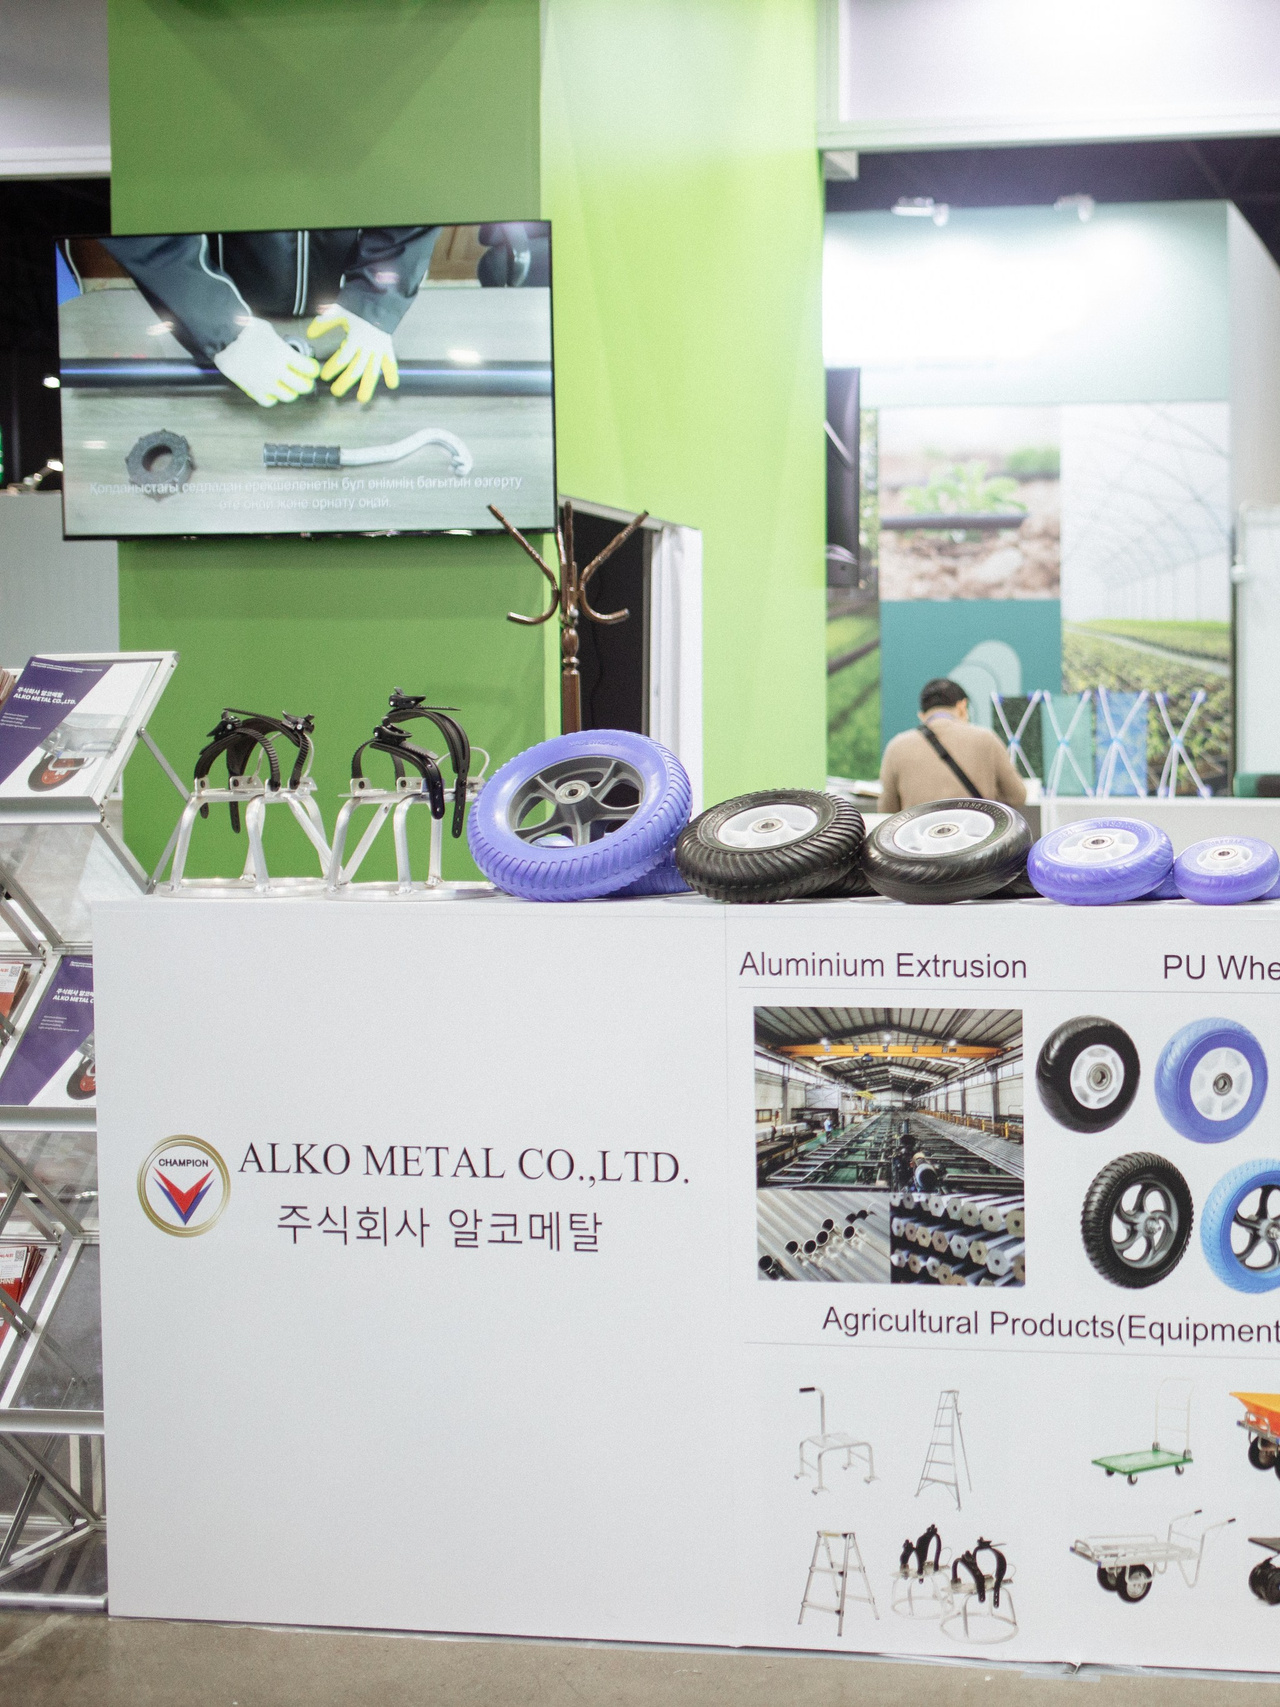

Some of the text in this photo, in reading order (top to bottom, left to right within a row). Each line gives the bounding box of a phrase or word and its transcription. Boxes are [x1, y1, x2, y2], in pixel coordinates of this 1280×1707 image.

[739, 951, 1027, 979] Aluminium Extrusion
[1163, 954, 1206, 981] PU
[158, 1157, 209, 1169] CHAMPION
[237, 1141, 689, 1188] ALKO METAL CO.,LTD.
[277, 1205, 603, 1253] 주식회사 알코메탈
[822, 1306, 979, 1338] Agricultural
